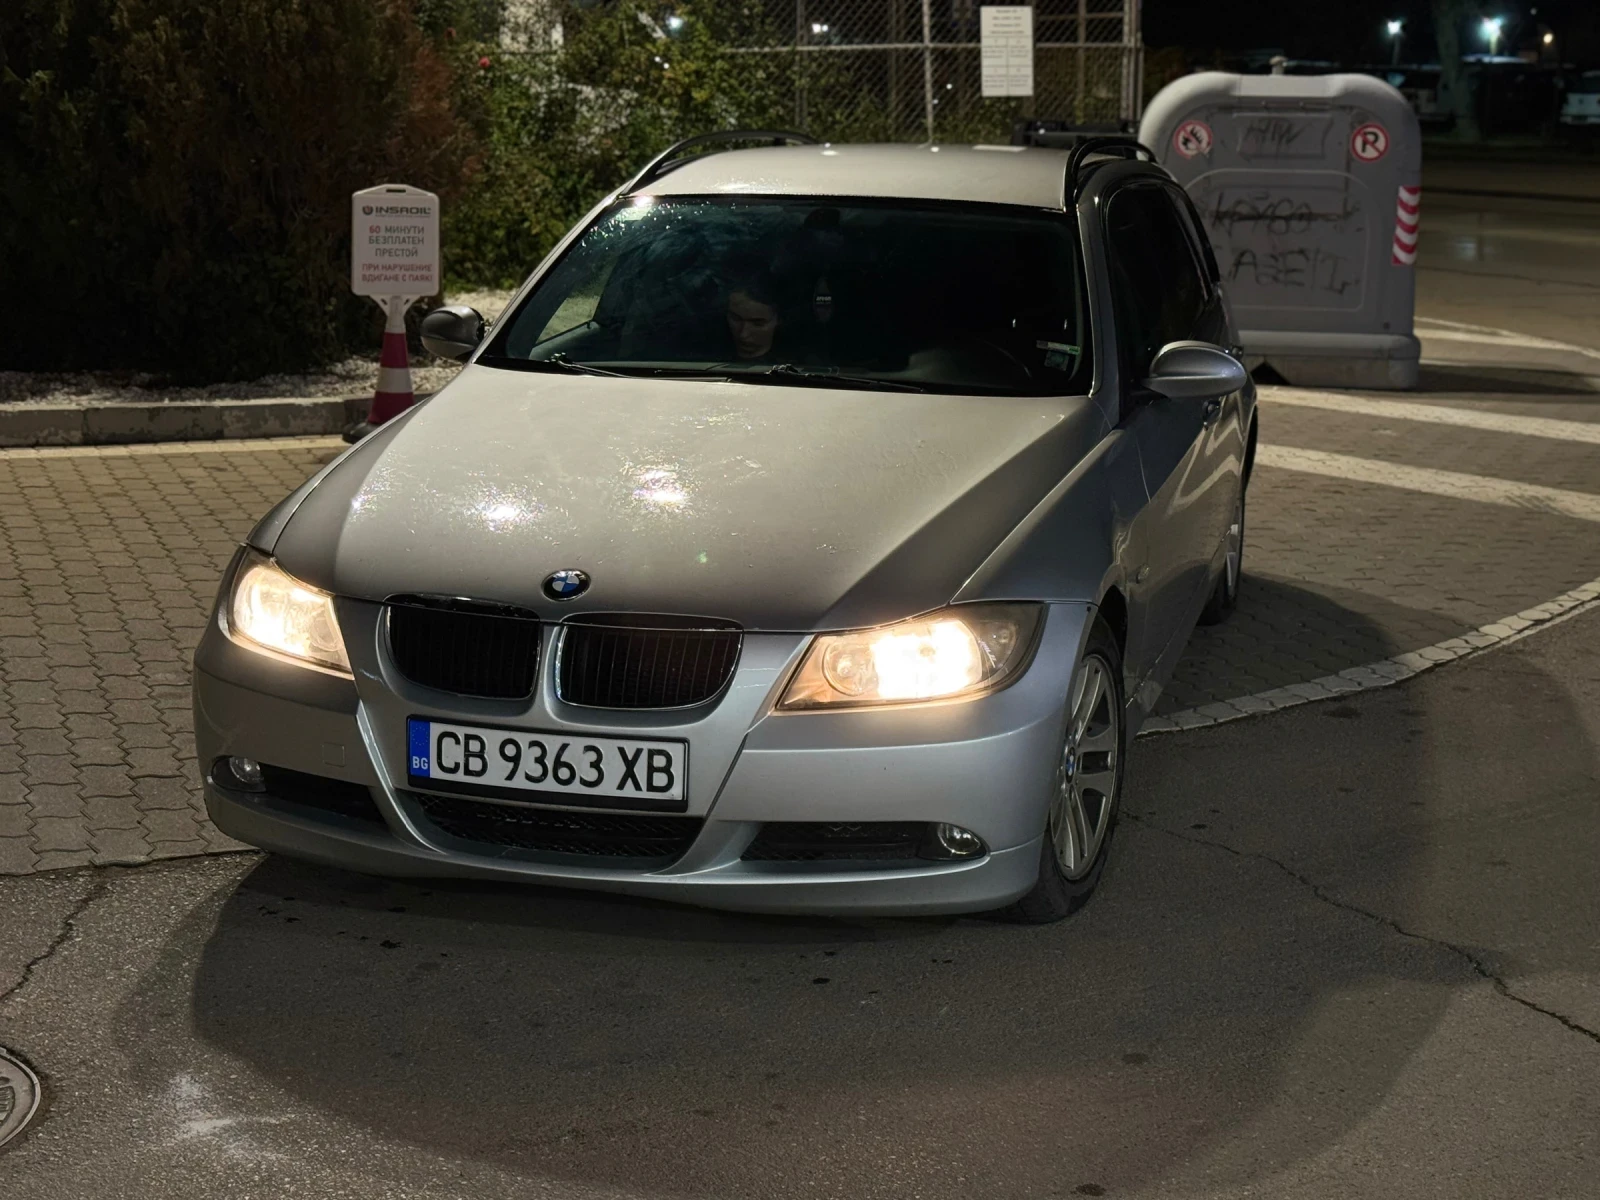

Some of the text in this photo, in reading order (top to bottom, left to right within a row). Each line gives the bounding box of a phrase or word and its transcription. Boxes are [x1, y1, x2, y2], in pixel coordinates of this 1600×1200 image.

[375, 206, 430, 214] INSAOIL
[369, 225, 424, 234] 60 МИНУТИ
[368, 236, 424, 245] БЕЗПЛАТЕН
[375, 247, 418, 257] ПРЕСТОЙ
[362, 263, 432, 272] ПРИ НАРУШЕНИЕ
[362, 274, 399, 282] ВДИГАНЕ
[412, 756, 428, 770] BG
[436, 731, 675, 793] CB 9363 XB
